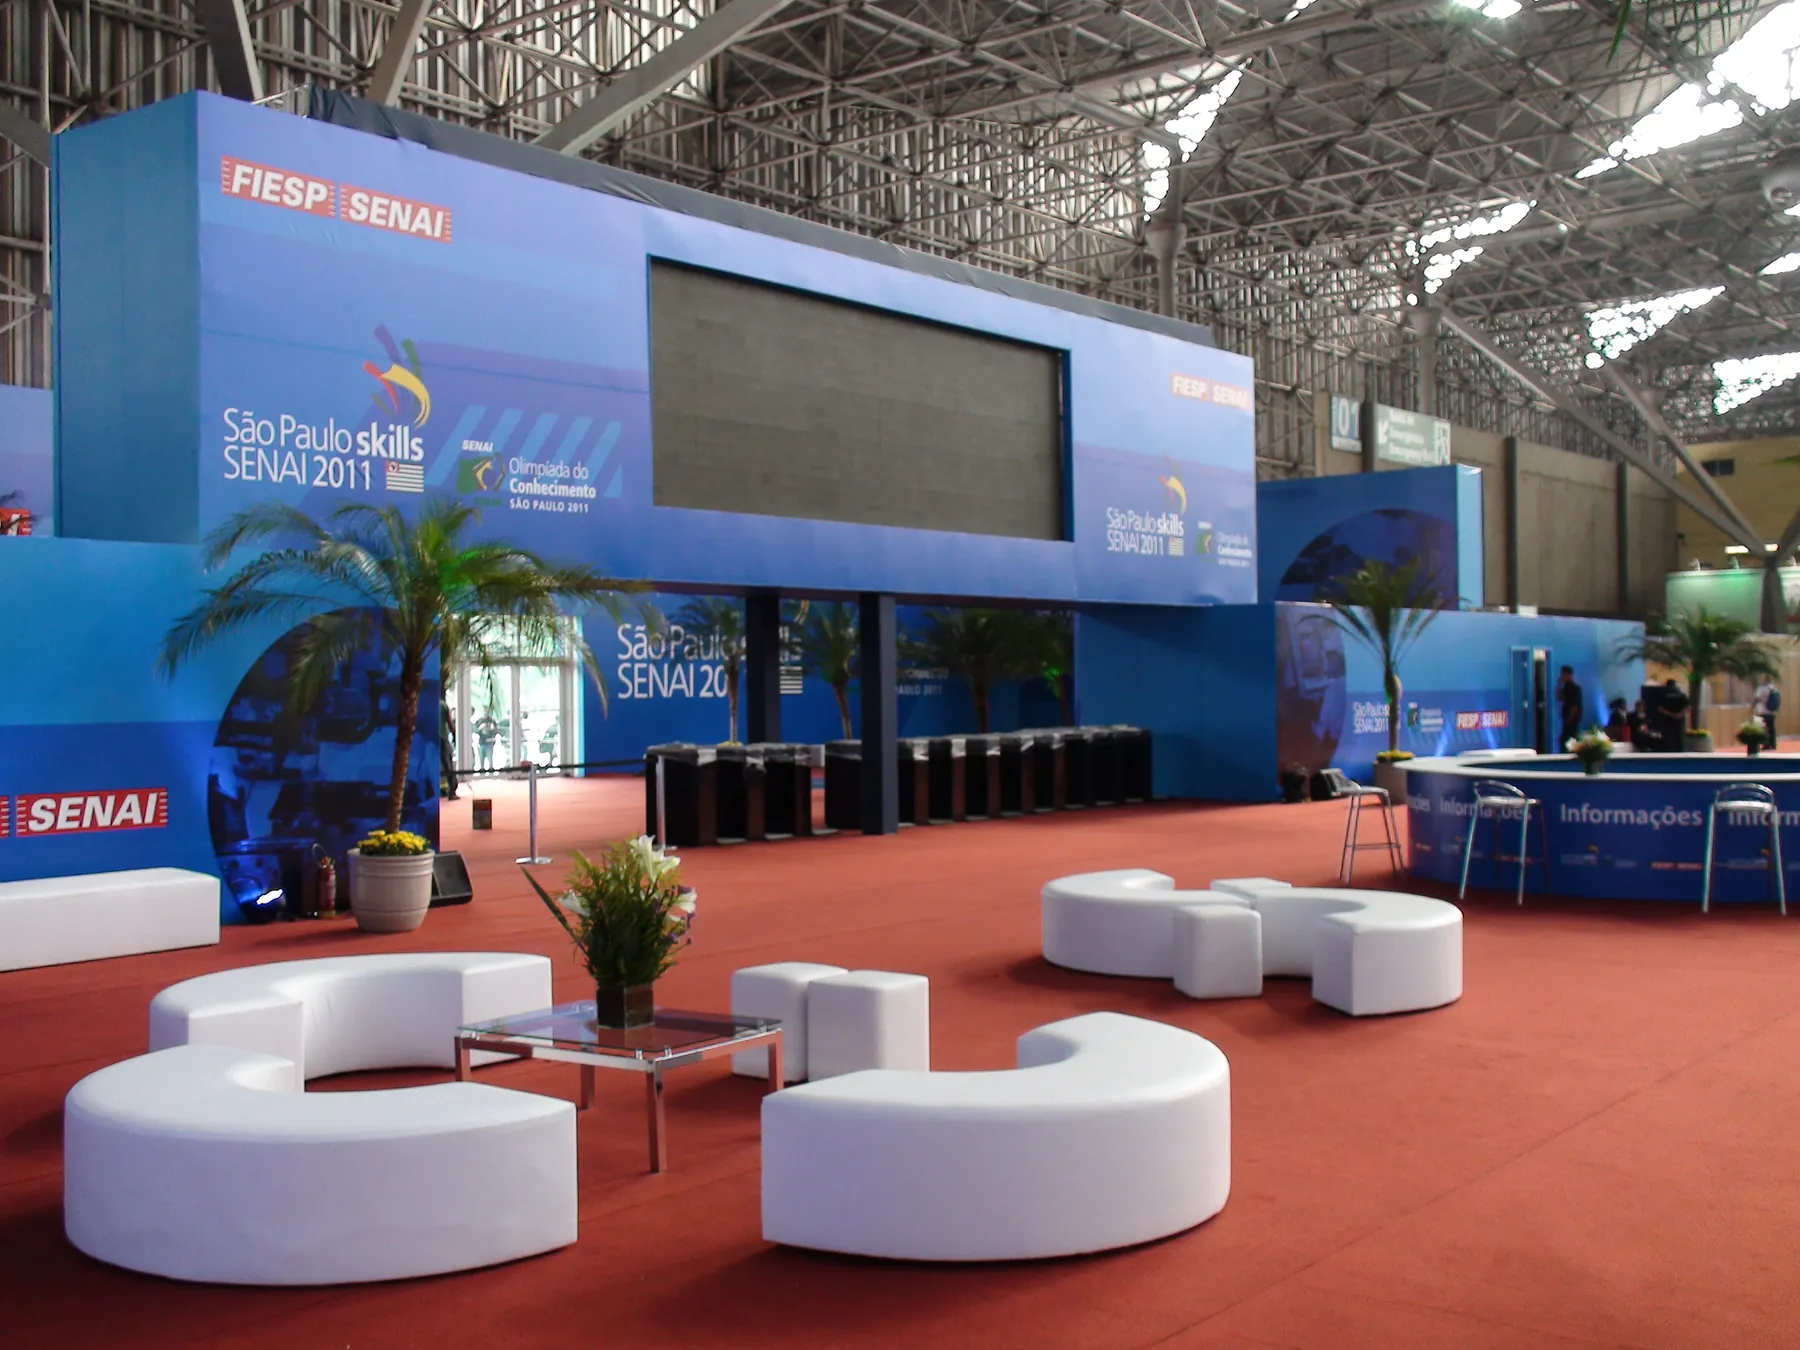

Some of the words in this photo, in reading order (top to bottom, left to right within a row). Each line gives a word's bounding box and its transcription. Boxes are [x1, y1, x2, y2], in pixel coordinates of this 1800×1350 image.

[231, 163, 329, 211] FIESP
[348, 191, 445, 239] SENAI
[1172, 375, 1207, 399] FIESP
[1212, 384, 1248, 411] SENAI
[223, 407, 275, 446] São
[280, 413, 353, 455] Paulo
[356, 421, 425, 462] skills
[462, 439, 494, 453] SENAI
[223, 445, 308, 485] SENAI
[312, 454, 371, 491] 2011
[509, 456, 570, 479] Olimpíada
[573, 461, 590, 480] do
[509, 477, 597, 499] Conhecimento
[509, 498, 530, 511] SÃO
[533, 499, 565, 512] PAULO
[567, 501, 589, 514] 2011
[1106, 506, 1127, 530] São
[1128, 510, 1157, 534] Paulo
[1157, 511, 1184, 537] skills
[1106, 529, 1140, 553] SENAI
[1141, 534, 1164, 556] 2011
[617, 622, 667, 660] São
[617, 662, 695, 699] SENAI
[28, 792, 158, 833] SENAI
[1561, 803, 1704, 830] Informações
